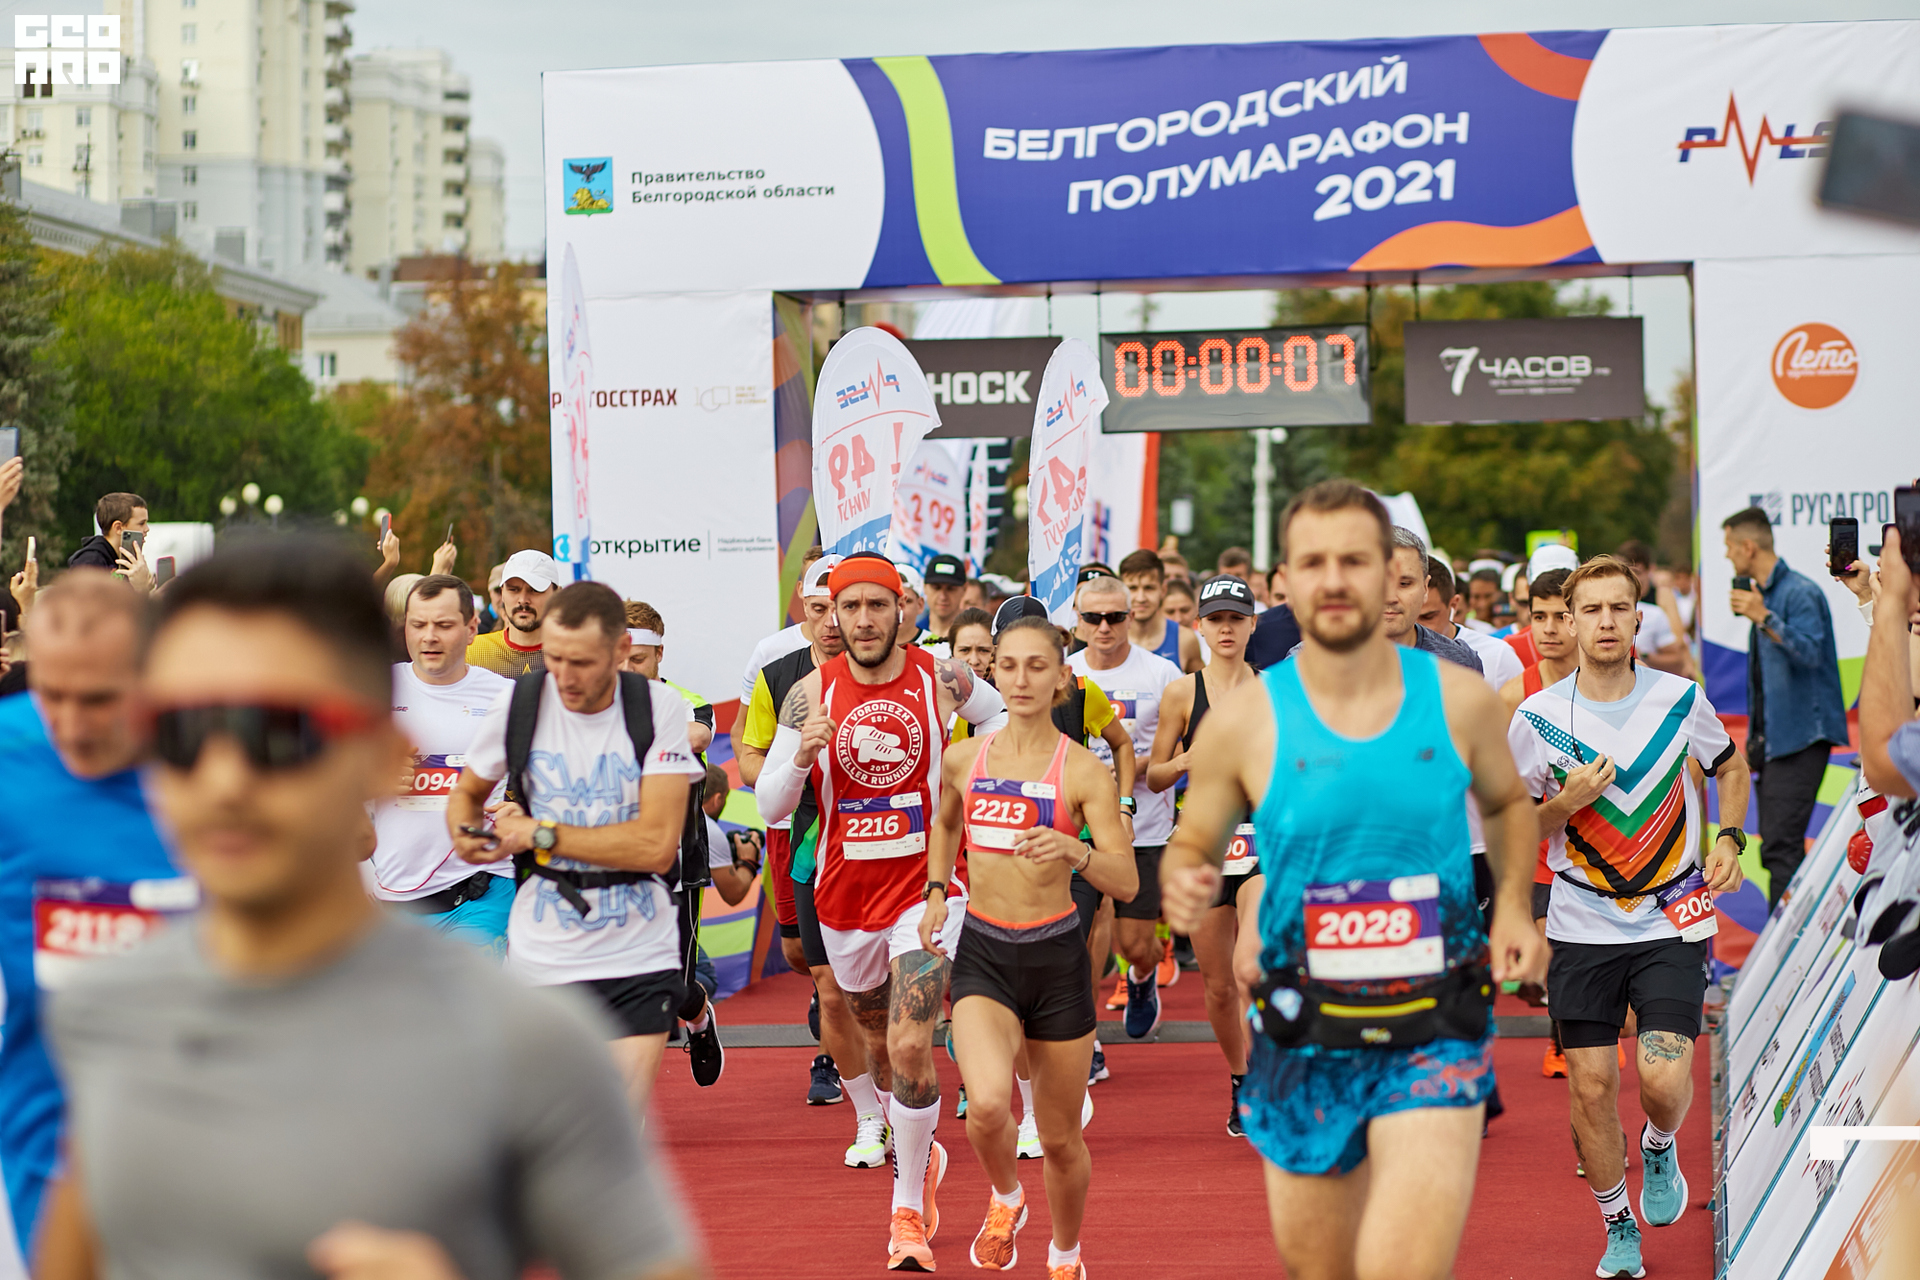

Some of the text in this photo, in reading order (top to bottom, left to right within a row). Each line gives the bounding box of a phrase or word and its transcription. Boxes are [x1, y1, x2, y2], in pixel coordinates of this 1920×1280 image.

[983, 54, 1409, 162] БЕЛГОРОДСКИЙ
[1066, 111, 1470, 214] ПОЛУМАРАФОН
[631, 168, 766, 187] Правительство
[1313, 158, 1457, 222] 2021
[632, 184, 835, 204] Белгородской области
[1114, 333, 1356, 398] 00:00:07
[1438, 346, 1593, 396] 7 ЧАСОВ
[925, 370, 1032, 405] HOCK
[1791, 491, 1889, 525] РУСАГРО
[590, 537, 701, 558] открытие
[1200, 580, 1246, 600] UFC
[850, 703, 911, 722] VORONEZH
[871, 715, 889, 723] EST
[839, 725, 921, 785] MIKKELLER RUNNING CLUB
[870, 763, 890, 772] 2017
[410, 773, 459, 791] 094
[970, 798, 1027, 825] 2213
[846, 814, 899, 838] 2216
[1314, 907, 1413, 946] 2028
